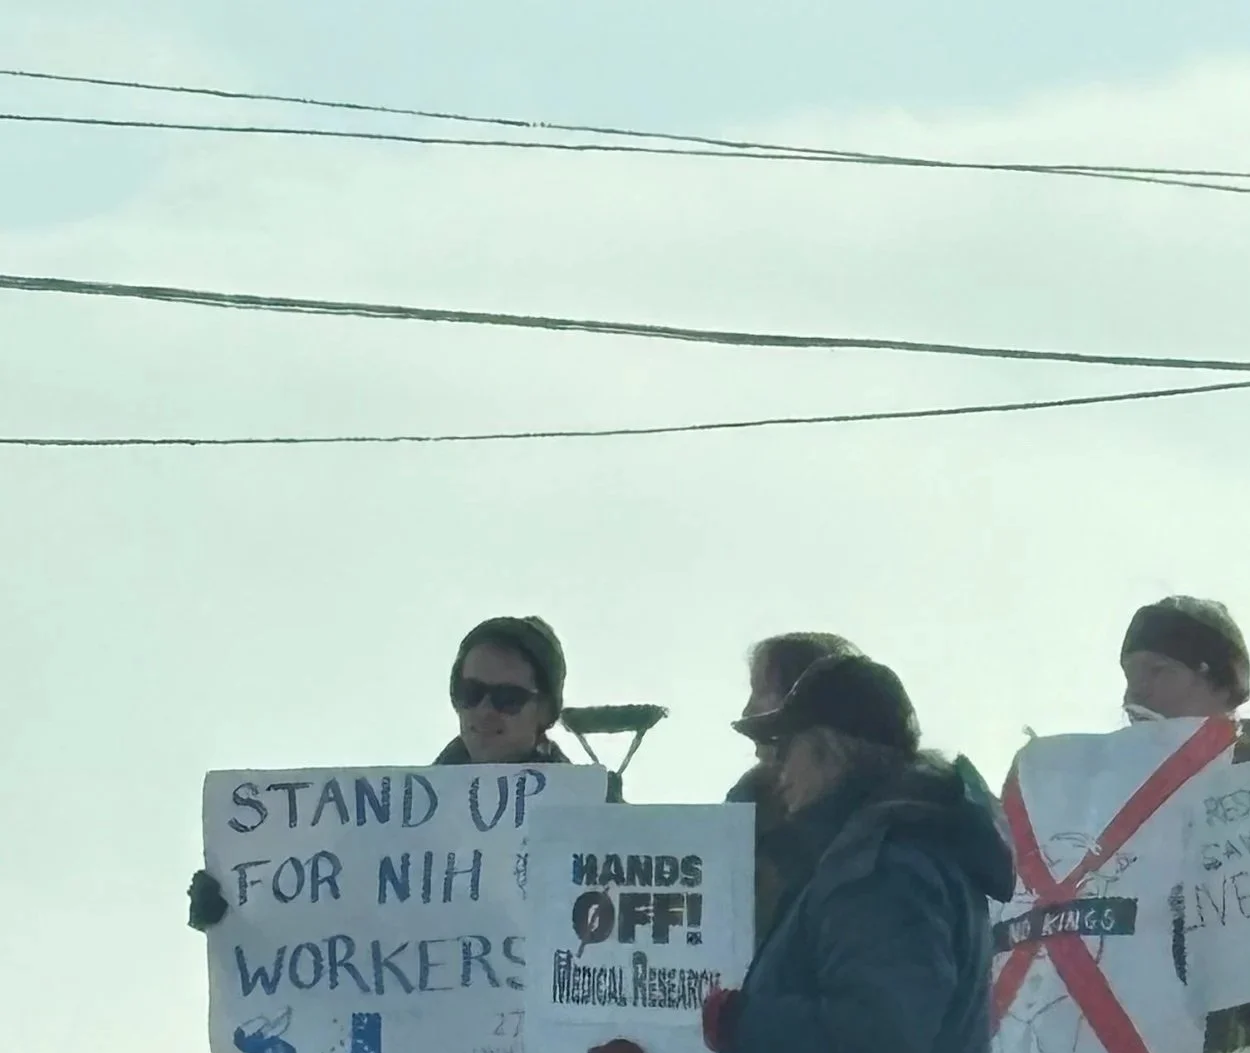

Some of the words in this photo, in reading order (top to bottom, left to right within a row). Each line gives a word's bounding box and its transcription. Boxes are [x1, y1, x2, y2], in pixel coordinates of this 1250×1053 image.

[228, 773, 438, 833] STAND
[468, 768, 547, 832] UP
[231, 850, 343, 906] FOR
[378, 849, 483, 905] NIH
[572, 853, 703, 888] HANDS
[1041, 908, 1116, 937] KINGS
[234, 933, 527, 997] WORKERS
